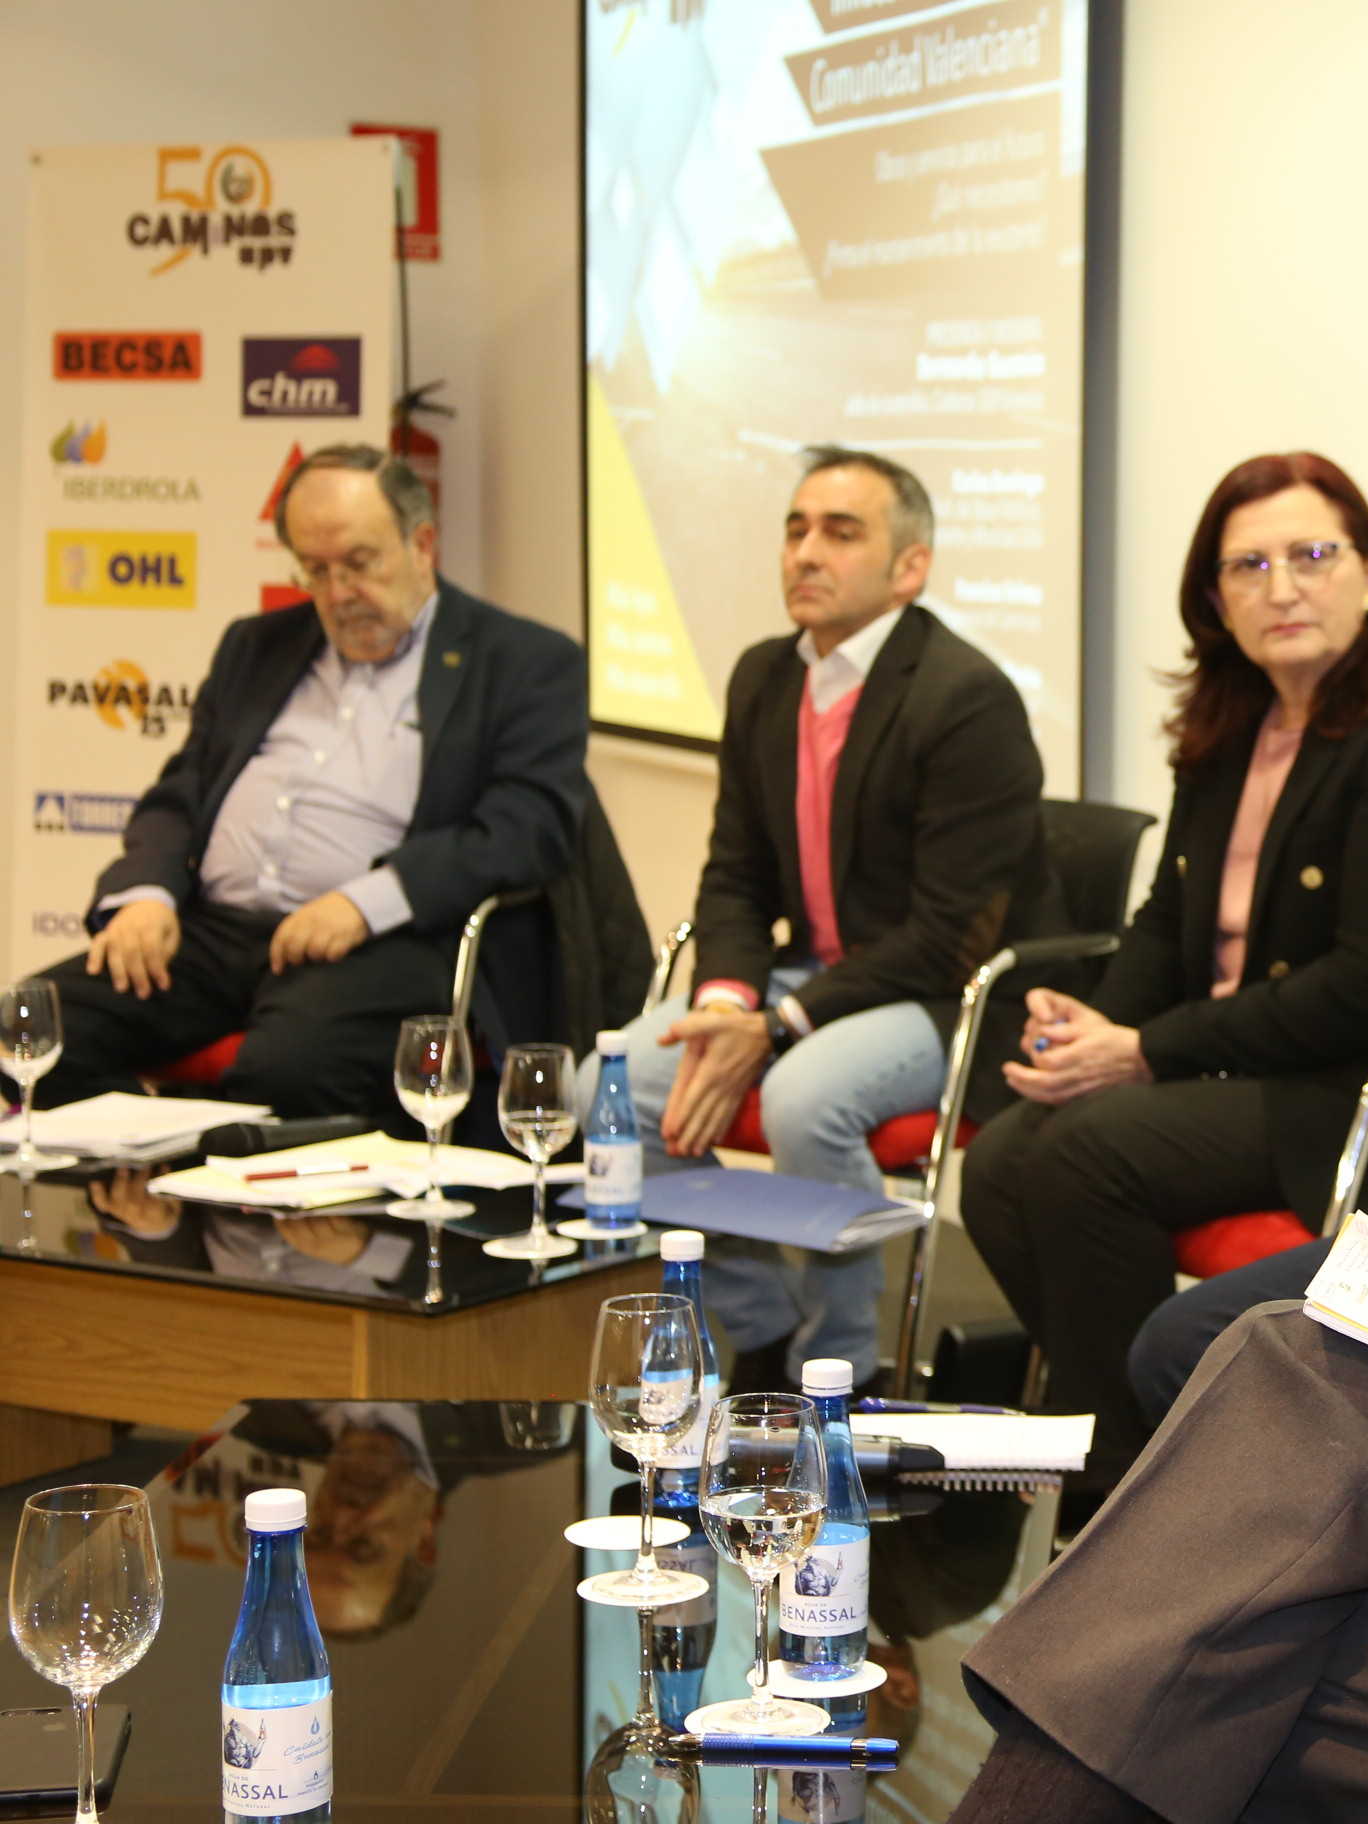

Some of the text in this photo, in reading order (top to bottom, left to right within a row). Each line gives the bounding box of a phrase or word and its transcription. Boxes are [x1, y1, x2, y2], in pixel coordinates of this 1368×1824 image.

[810, 40, 921, 113] Comunidad
[61, 341, 194, 374] BECSA
[246, 371, 338, 409] chm
[64, 476, 199, 501] IBERDROLA
[108, 554, 185, 587] OHL
[48, 680, 191, 707] PAVASAL
[33, 913, 83, 937] IDO
[781, 1603, 857, 1623] BENASSAL
[223, 1778, 288, 1799] NASSAL
